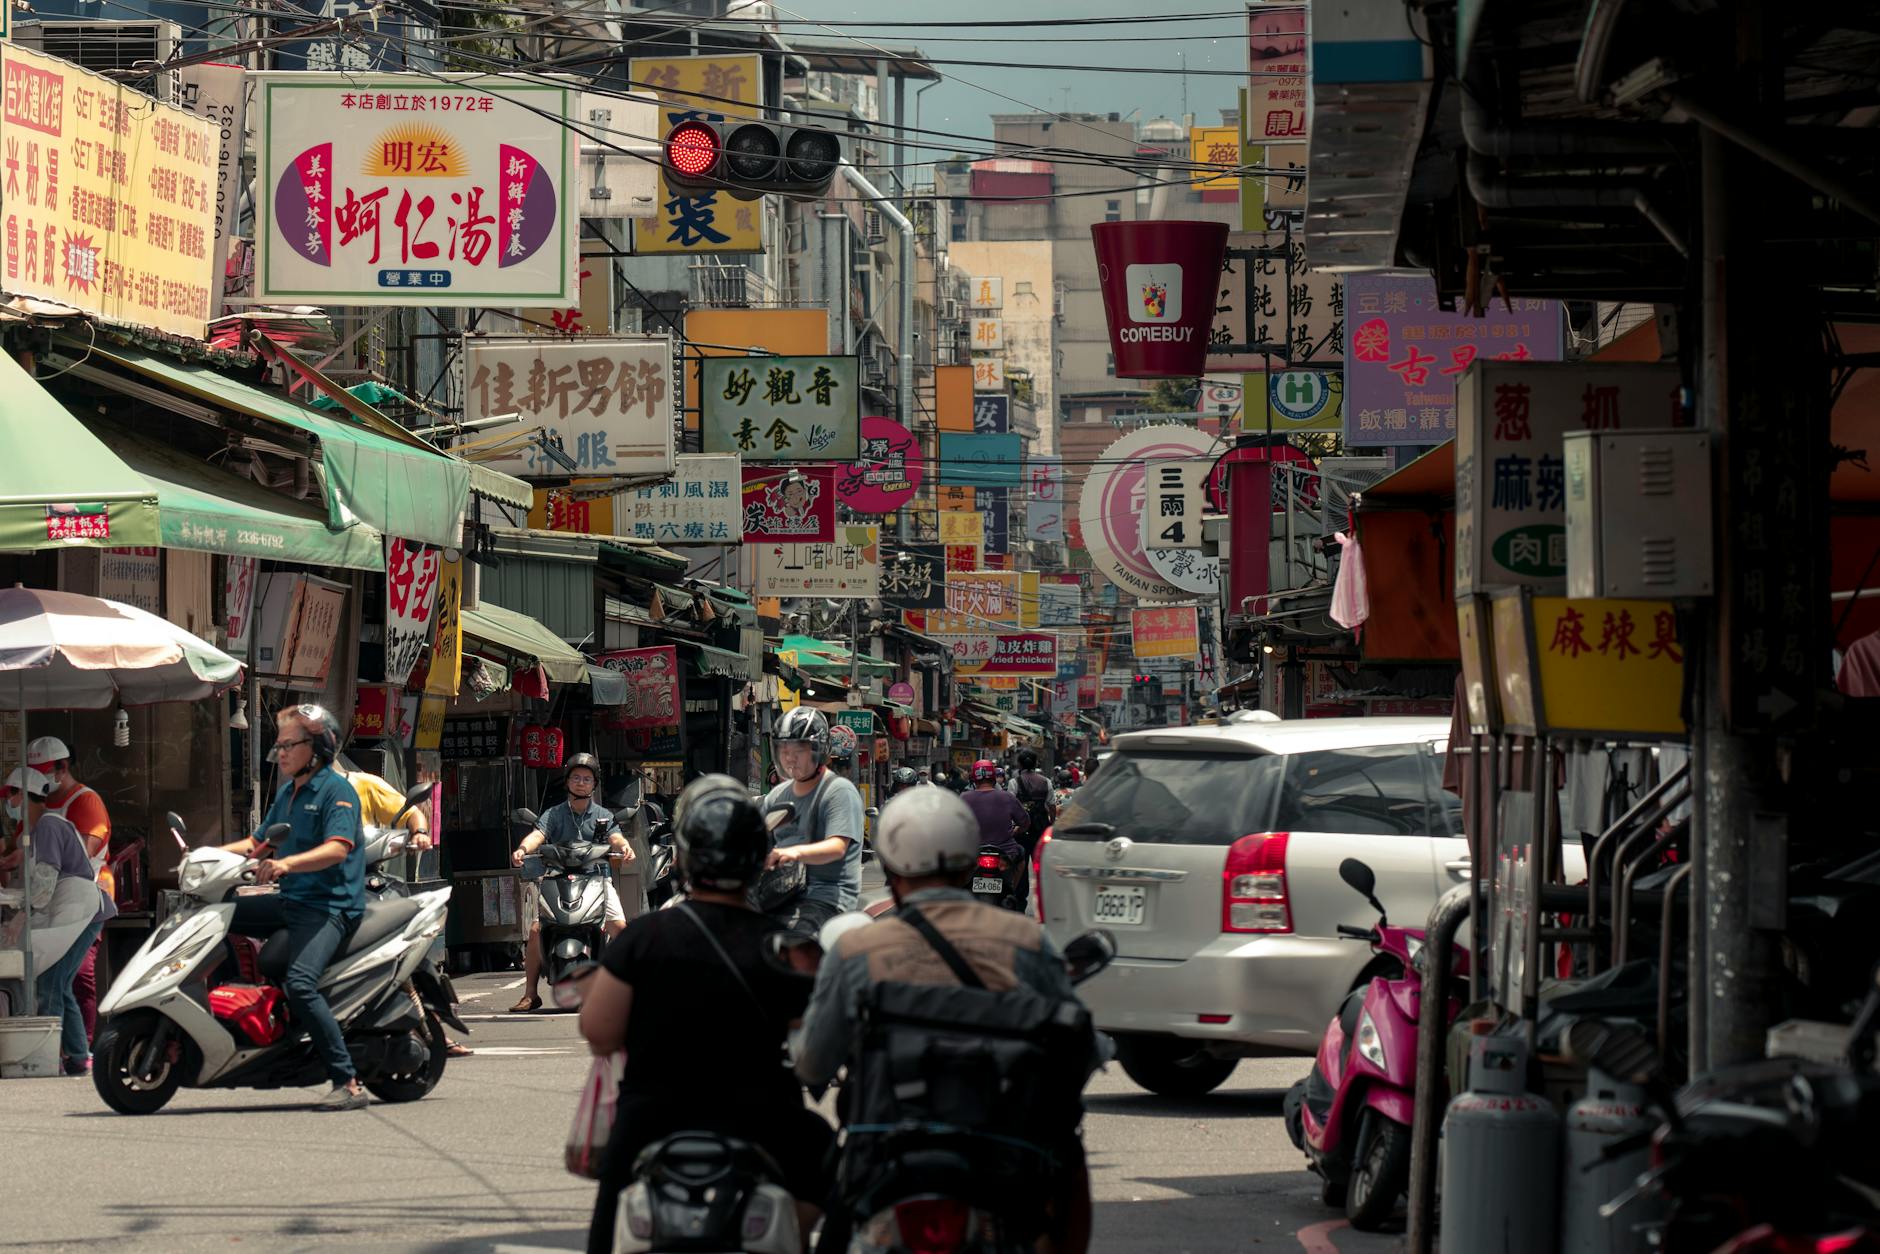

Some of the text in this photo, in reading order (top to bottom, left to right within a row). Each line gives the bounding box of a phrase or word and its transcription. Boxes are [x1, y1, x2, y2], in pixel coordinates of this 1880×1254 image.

[306, 42, 371, 71] 銀樓
[6, 66, 62, 131] 台北通化街
[76, 86, 95, 120] SET
[340, 93, 495, 113] 本店創立於1972年
[74, 137, 93, 170] SET
[382, 140, 449, 173] 明宏
[6, 136, 59, 211] 米粉湯
[214, 104, 235, 240] 0920-316-032
[664, 110, 731, 246] 裝
[304, 154, 327, 254] 美味芬芳
[505, 156, 528, 257] 新鮮營養
[335, 186, 496, 265] 蚵仁湯
[385, 271, 445, 286] 營業中
[1119, 326, 1194, 343] COMEBUY
[470, 358, 666, 420] 佳新男飾
[723, 365, 840, 407] 妙觀音
[527, 429, 617, 472] 洋服
[732, 417, 837, 452] 素食 Veggie
[50, 527, 107, 539] 2336-6792
[237, 530, 284, 549] 2336-6792
[634, 521, 729, 539] 點穴療法
[1112, 562, 1150, 591] TAIWAN
[1151, 584, 1187, 596] SPOR
[991, 656, 1054, 664] fried chicken
[844, 715, 871, 729] 長安街
